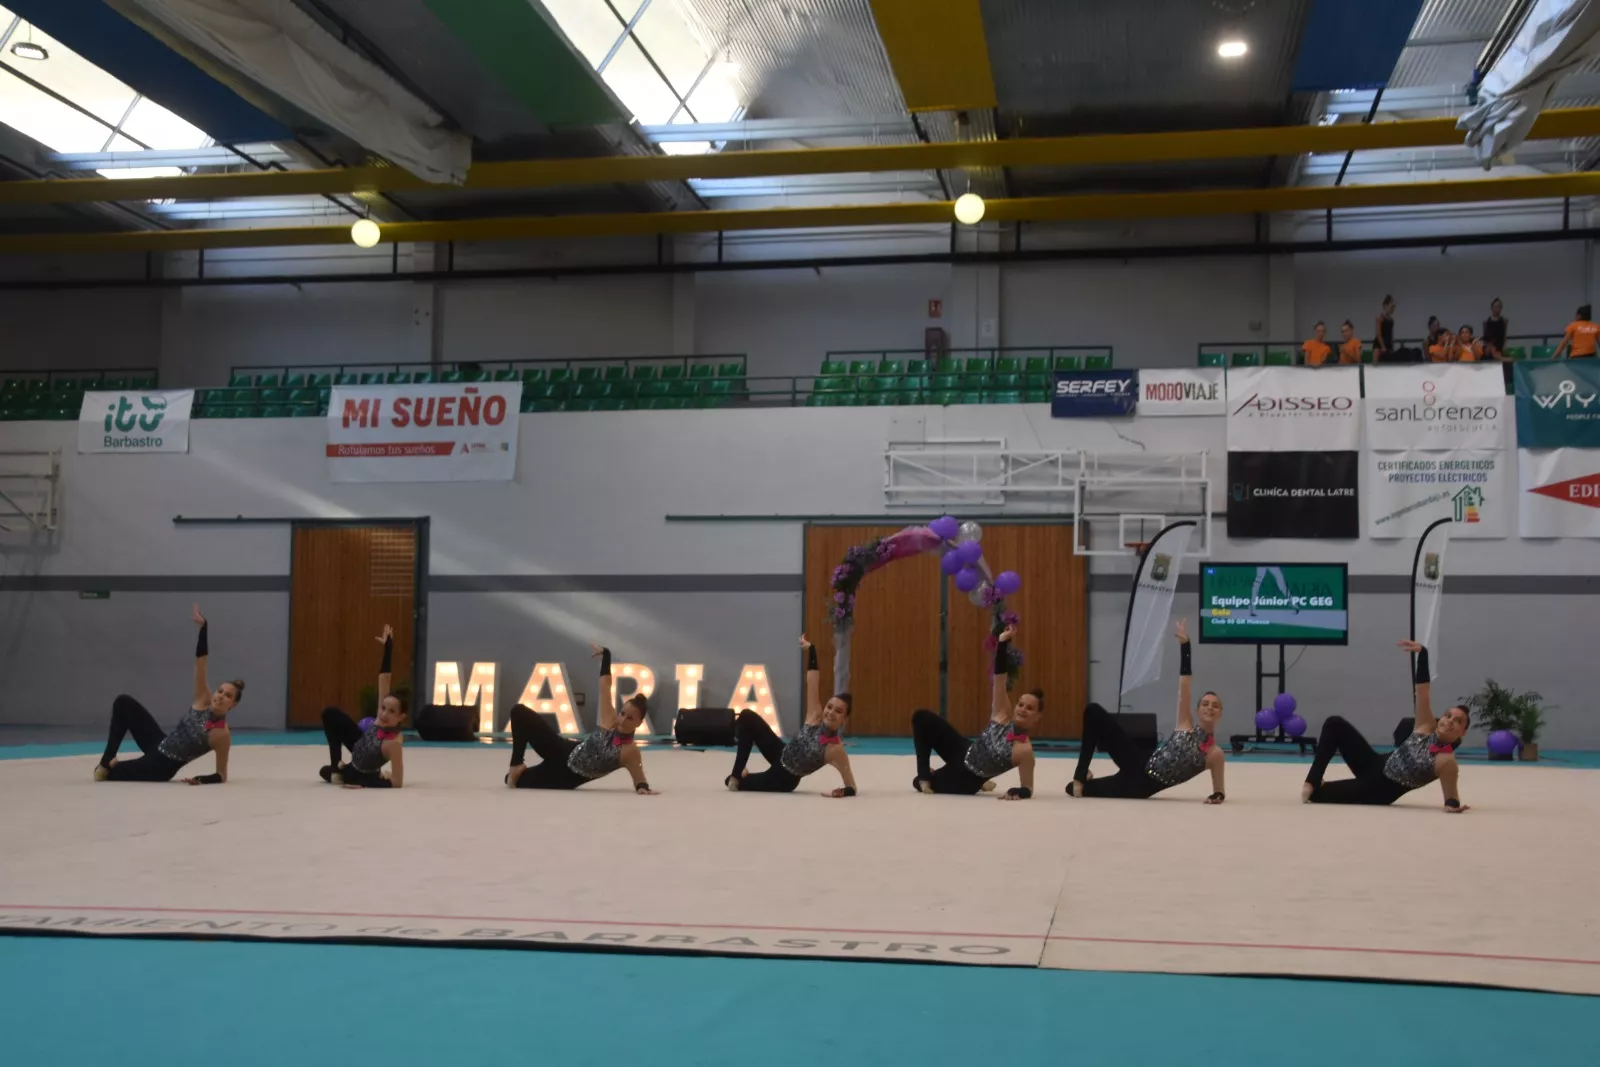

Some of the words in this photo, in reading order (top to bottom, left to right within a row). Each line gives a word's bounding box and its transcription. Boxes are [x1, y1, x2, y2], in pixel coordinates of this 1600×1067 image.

[1056, 379, 1131, 394] SERFEY
[342, 399, 382, 429] MI
[391, 387, 507, 428] SUEÑO
[103, 436, 164, 448] Barbastro
[338, 444, 386, 456] Rotulamos
[388, 444, 402, 456] tus
[1377, 461, 1437, 471] CERTIFICADOS
[1388, 473, 1437, 483] PROYECTOS
[1291, 488, 1326, 497] DENTAL
[1327, 488, 1355, 496] LATRE
[1211, 596, 1251, 607] Equipo
[1253, 595, 1290, 606] Júnior
[1291, 597, 1307, 606] PC
[1309, 597, 1334, 607] GEG
[433, 661, 784, 736] MARIA
[0, 915, 338, 931] AMIENTO
[356, 925, 442, 936] de
[459, 928, 1011, 956] BARBASTRO
